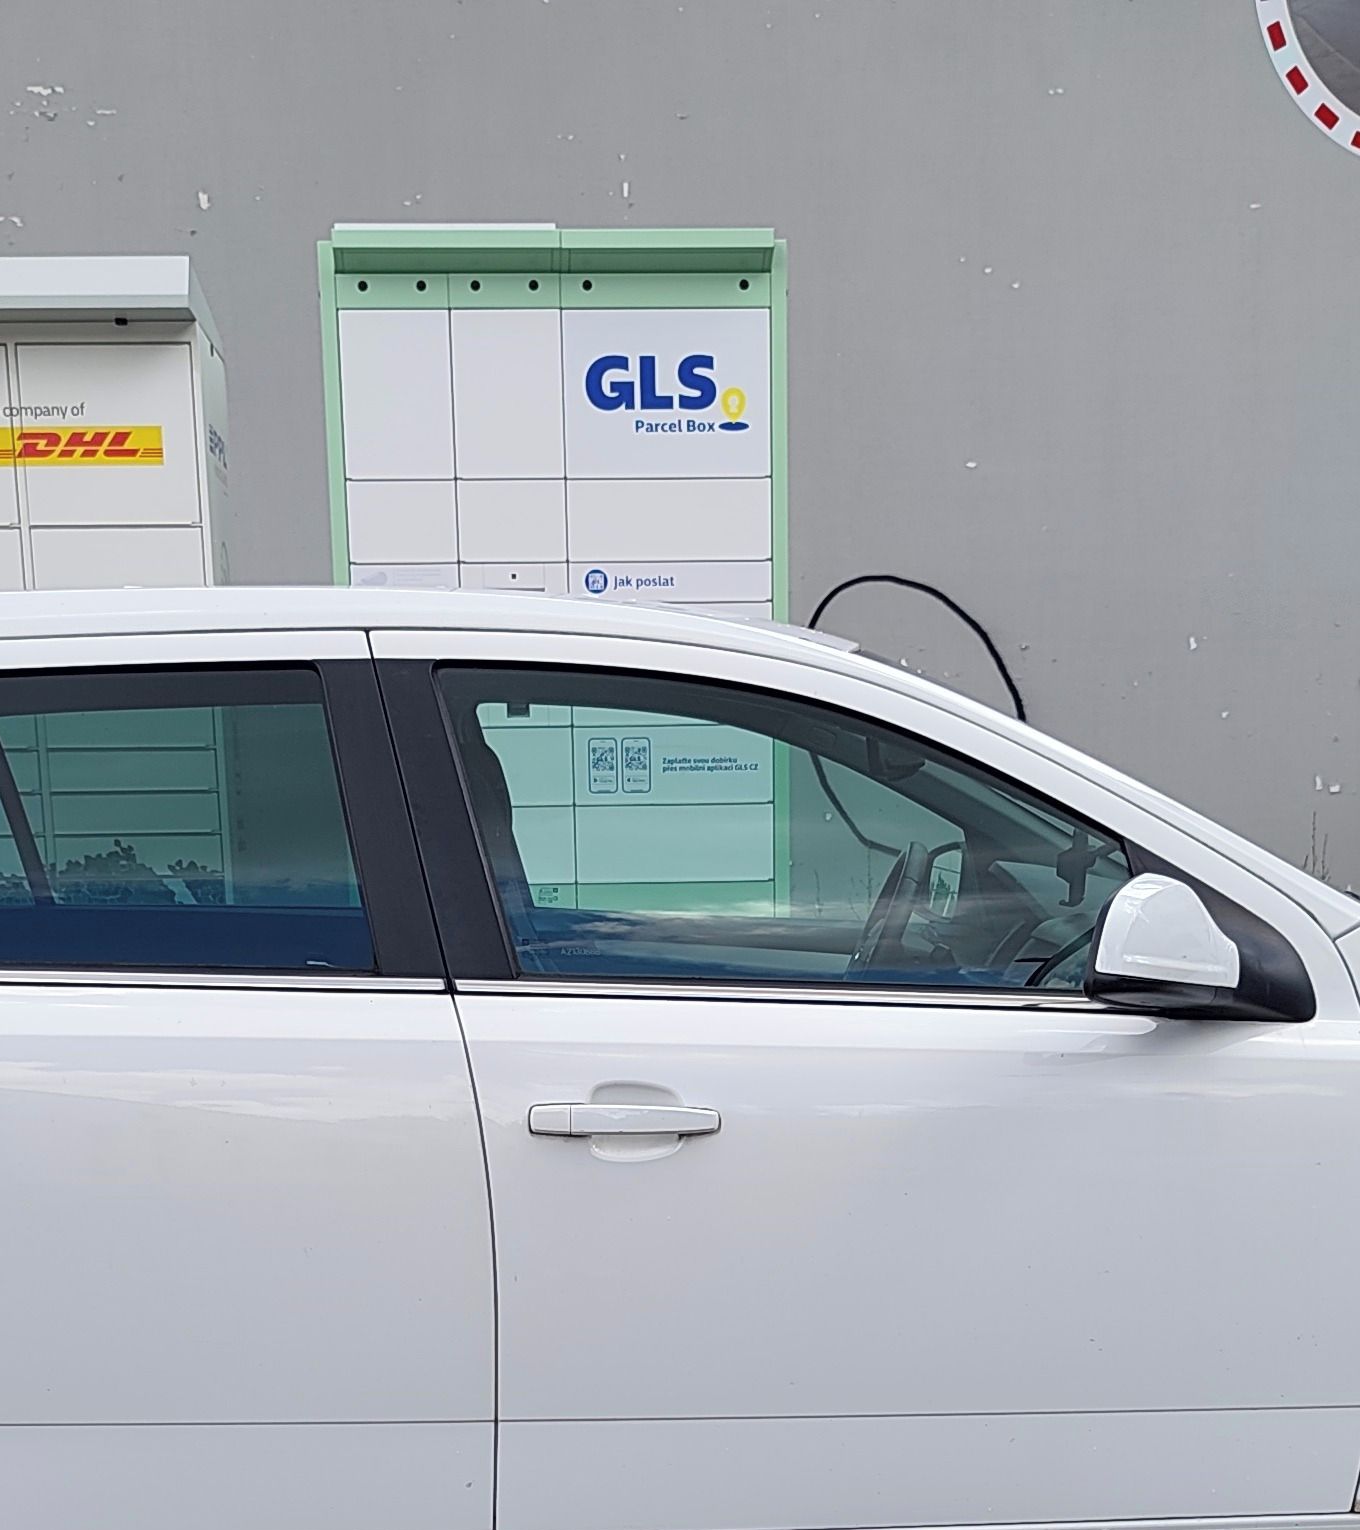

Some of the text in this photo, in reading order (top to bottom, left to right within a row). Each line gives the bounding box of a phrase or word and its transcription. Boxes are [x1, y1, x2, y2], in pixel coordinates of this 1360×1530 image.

[585, 354, 717, 411] GLS
[3, 404, 68, 419] company
[71, 402, 86, 417] of
[634, 419, 717, 433] Parcel Box
[16, 431, 141, 459] DHL
[613, 573, 675, 590] Jak poslat
